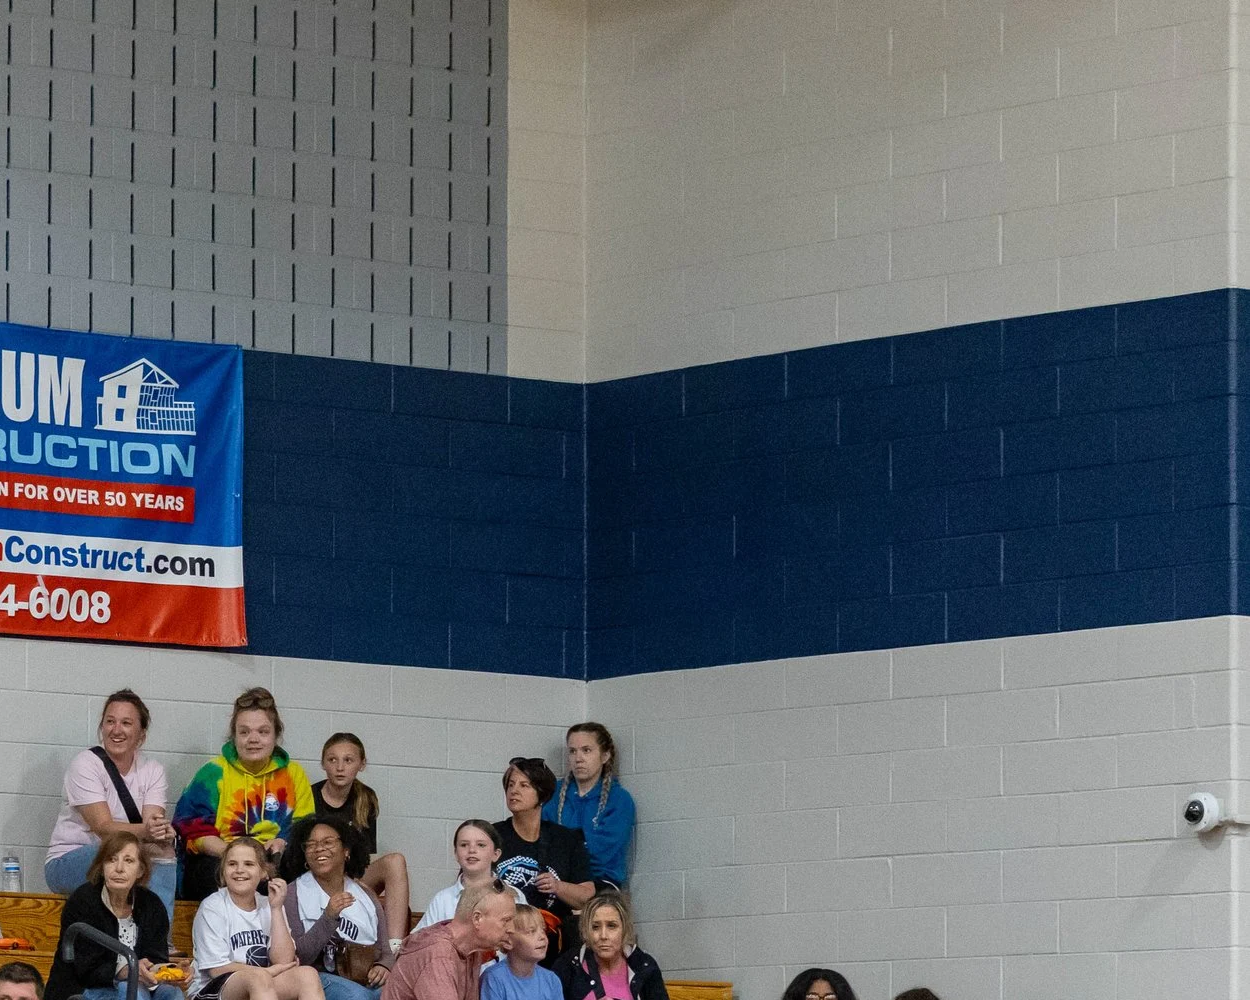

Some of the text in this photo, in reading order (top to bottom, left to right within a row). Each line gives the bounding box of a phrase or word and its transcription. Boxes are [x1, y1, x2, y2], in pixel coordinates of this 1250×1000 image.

[14, 482, 49, 500] FOR
[53, 487, 99, 506] OVER
[104, 491, 127, 508] 50
[131, 493, 185, 512] YEARS
